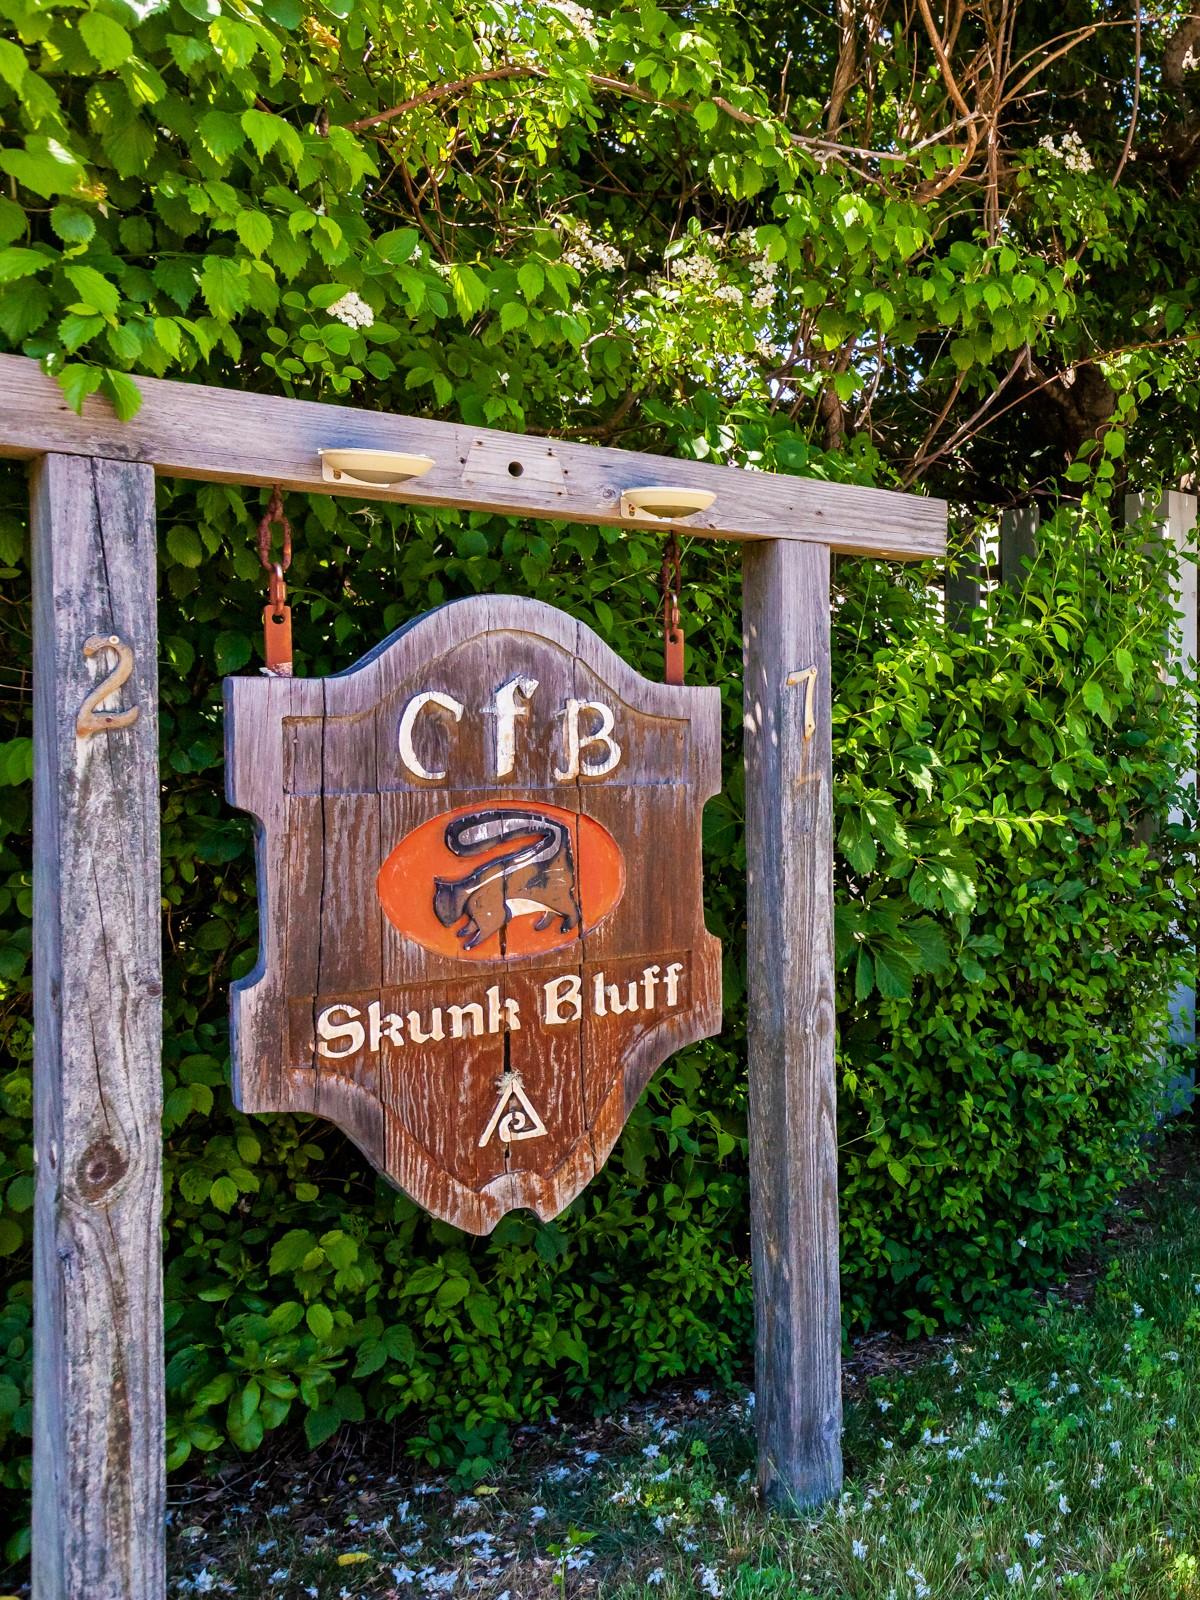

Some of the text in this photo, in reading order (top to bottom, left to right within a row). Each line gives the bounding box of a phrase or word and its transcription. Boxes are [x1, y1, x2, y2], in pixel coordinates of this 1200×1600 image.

[76, 632, 139, 738] 2
[786, 665, 817, 741] 7
[310, 961, 684, 1060] Skunk Bluff
